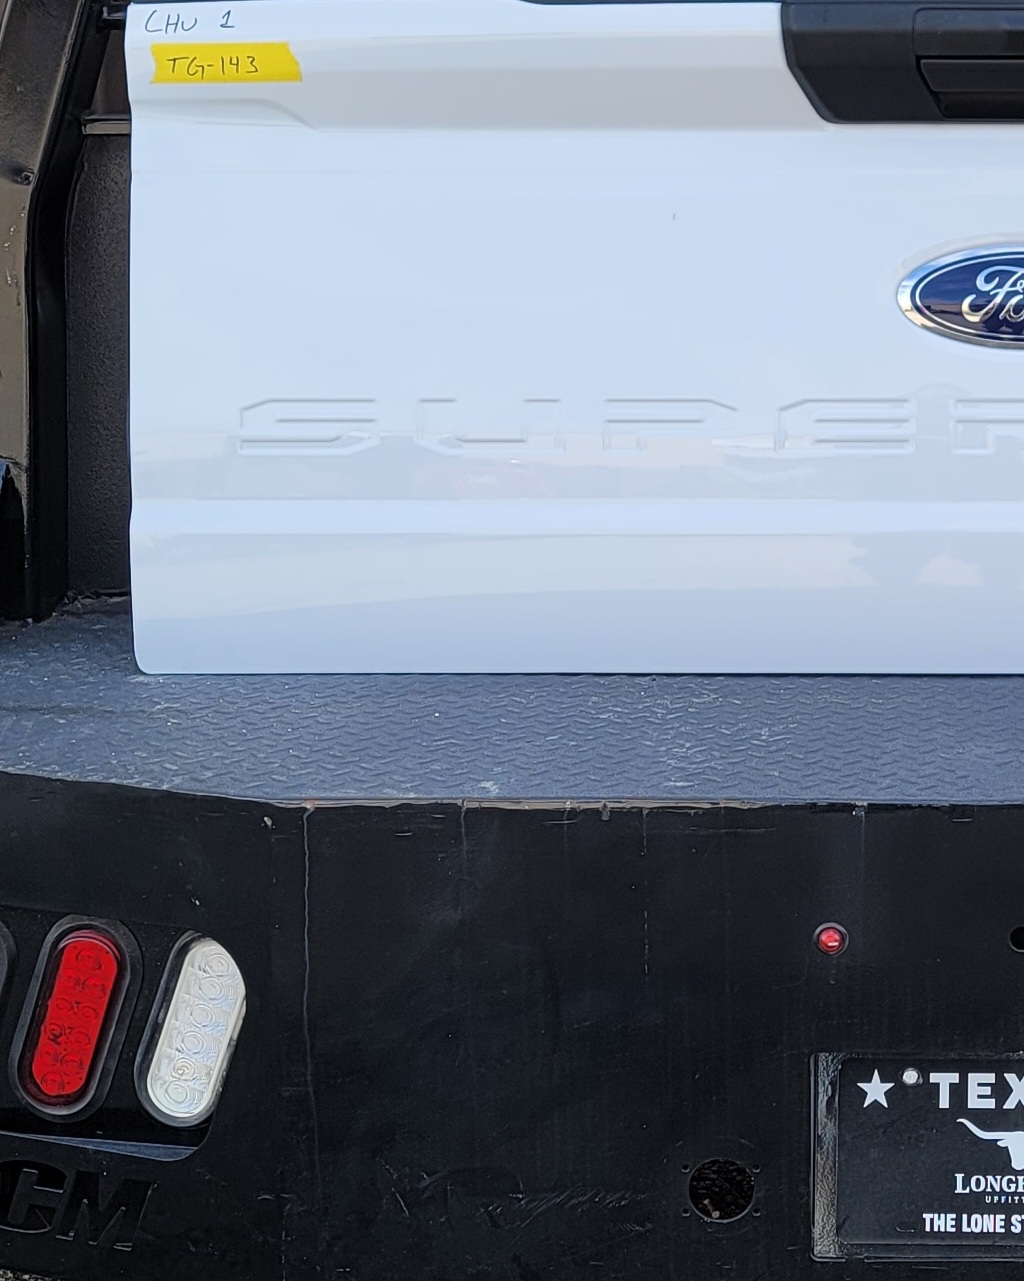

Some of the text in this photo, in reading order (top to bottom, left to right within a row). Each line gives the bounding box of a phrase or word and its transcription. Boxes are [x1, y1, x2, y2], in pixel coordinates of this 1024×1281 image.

[166, 55, 260, 81] TG-143
[923, 1213, 956, 1233] THE
[961, 1213, 1006, 1233] LONE
